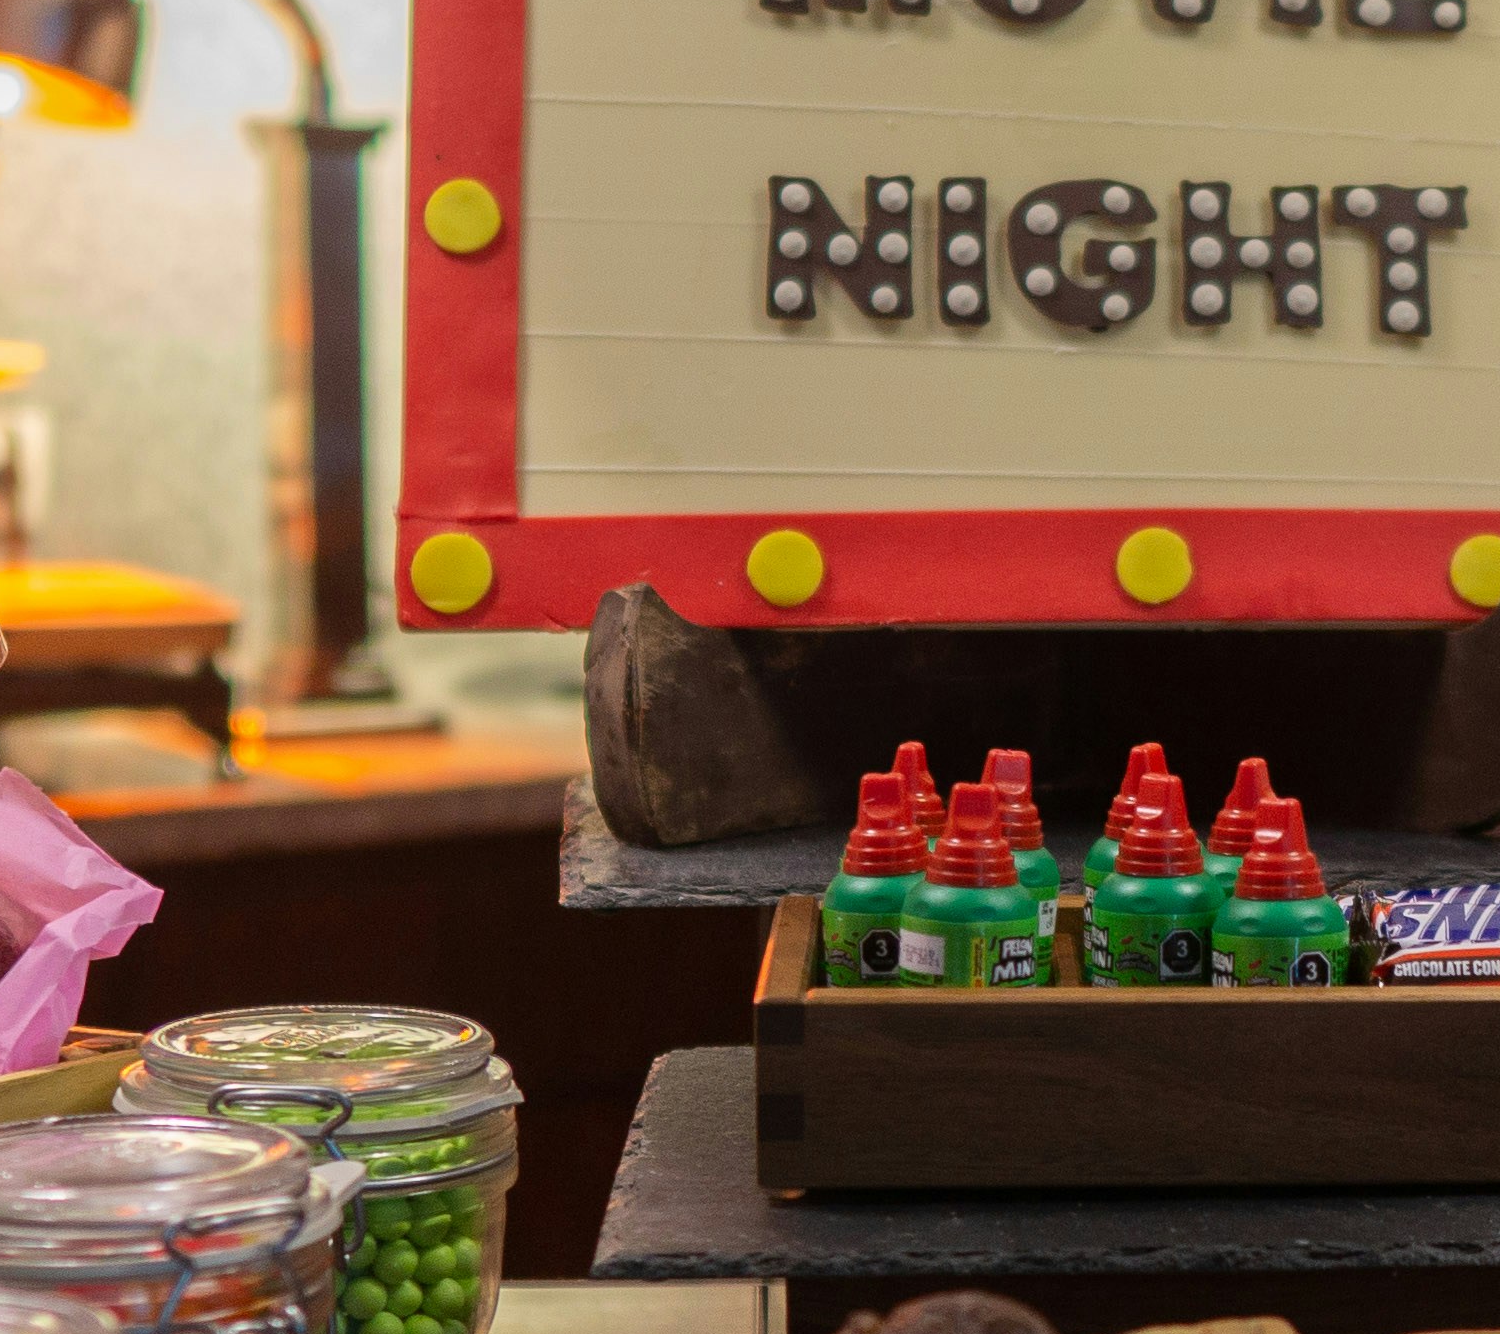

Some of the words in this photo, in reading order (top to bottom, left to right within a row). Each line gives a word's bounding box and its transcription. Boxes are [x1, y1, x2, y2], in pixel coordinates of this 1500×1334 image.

[766, 174, 1469, 338] NIGHT
[875, 939, 888, 957] 3
[1176, 939, 1188, 958] 3
[1305, 961, 1318, 981] 3
[1394, 961, 1469, 977] CHOCOLATE
